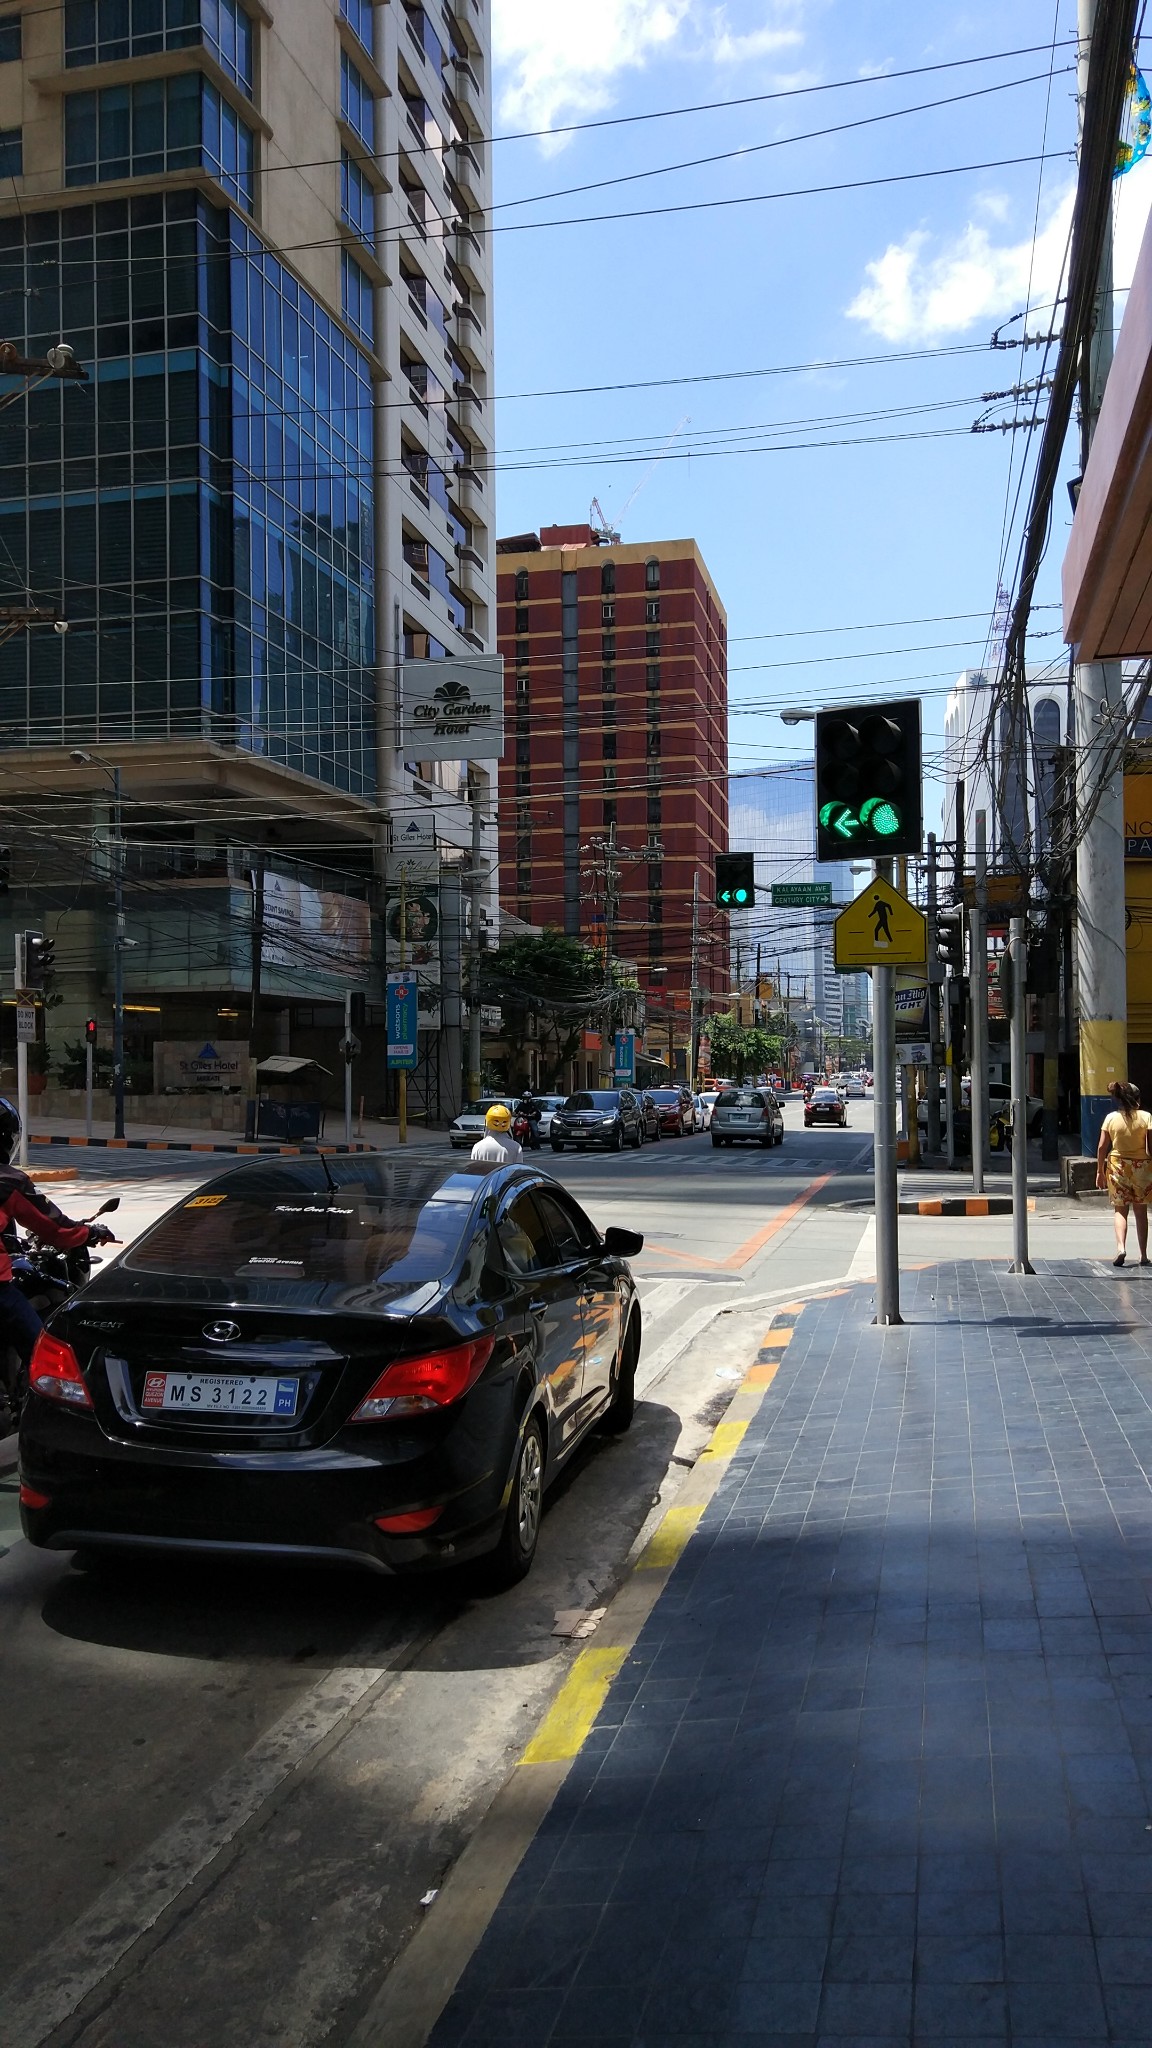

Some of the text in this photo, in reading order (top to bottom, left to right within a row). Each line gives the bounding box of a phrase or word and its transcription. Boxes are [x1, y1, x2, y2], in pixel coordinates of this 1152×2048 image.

[414, 702, 491, 717] City Garden
[401, 833, 415, 842] Giles
[417, 832, 433, 841] Hotel
[776, 885, 812, 893] KALAYAAN
[774, 896, 804, 904] CENTURY
[896, 1001, 921, 1011] IGHT
[18, 1010, 34, 1019] DO NOT
[19, 1021, 33, 1029] BLOCK
[180, 1060, 238, 1070] St Giles Hotel
[78, 1320, 124, 1328] ACCENT
[200, 1378, 244, 1386] REGISTERED
[212, 1387, 268, 1406] 3122
[278, 1399, 291, 1407] PH
